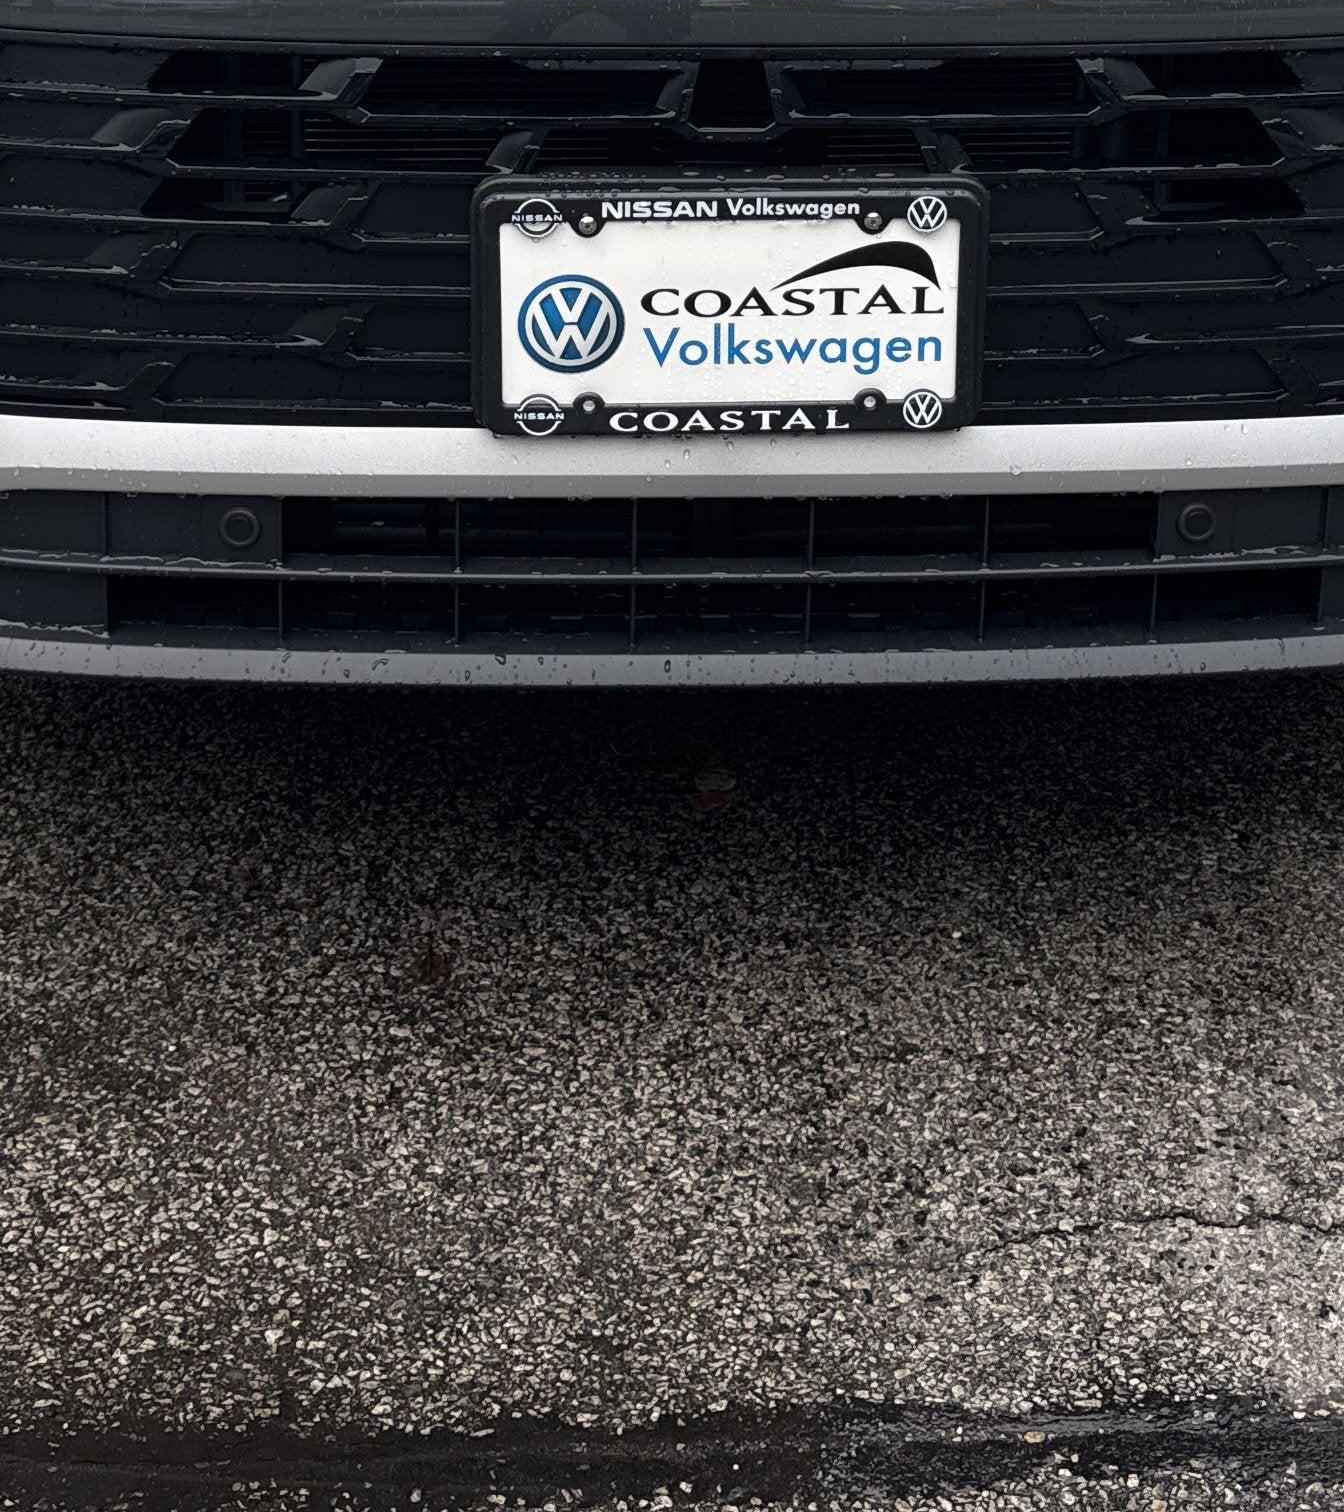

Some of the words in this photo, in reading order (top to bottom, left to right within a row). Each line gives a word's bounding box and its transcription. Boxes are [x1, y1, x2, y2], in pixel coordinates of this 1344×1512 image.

[511, 213, 563, 222] NISSAN
[602, 200, 718, 218] NISSAN
[726, 197, 861, 218] Volkswagen
[641, 285, 944, 317] COASTAL
[643, 322, 942, 375] Volkswagen
[514, 412, 565, 421] NISSAN
[609, 408, 850, 432] COASTAL
